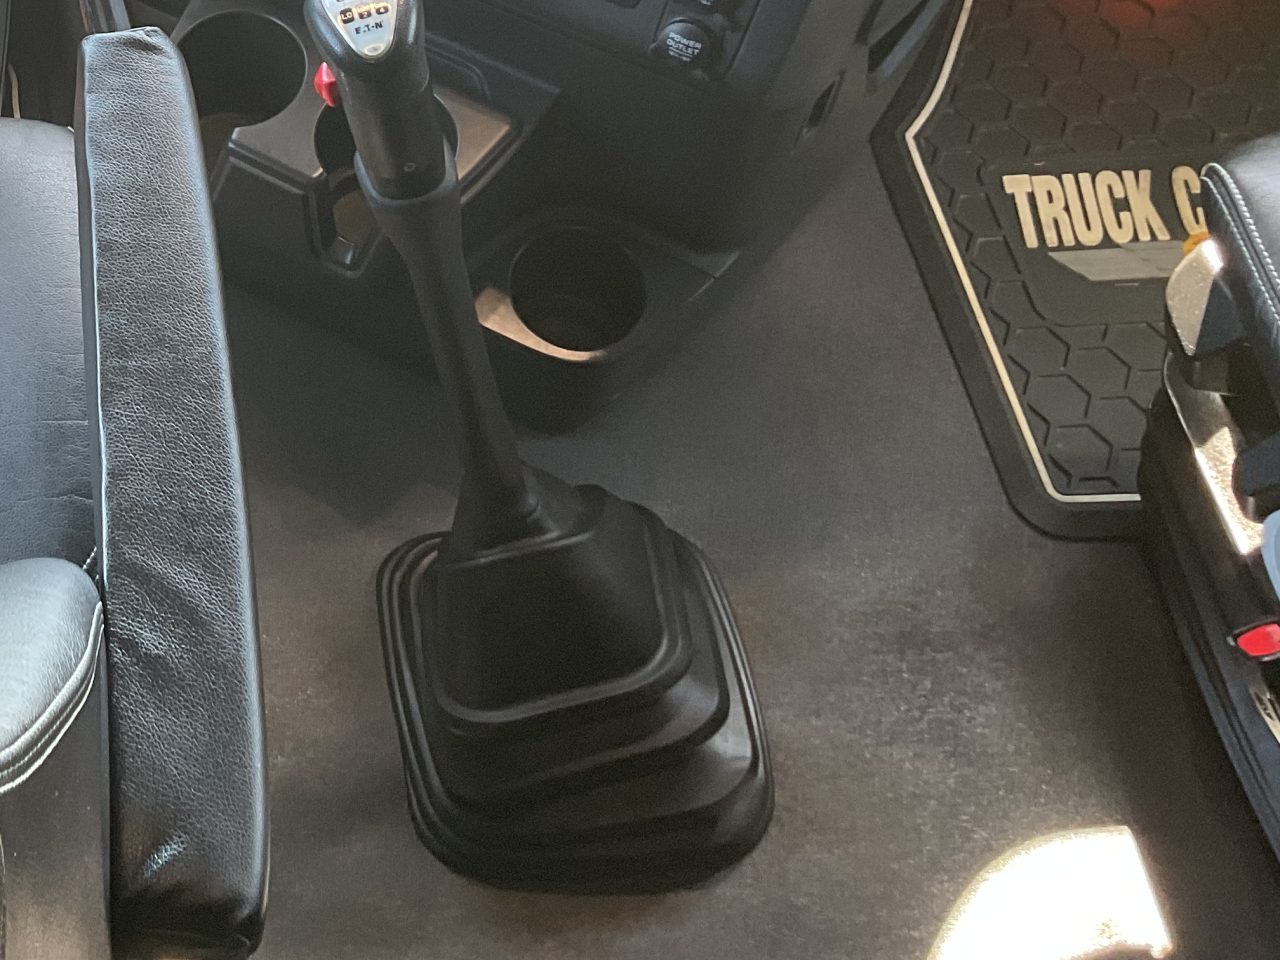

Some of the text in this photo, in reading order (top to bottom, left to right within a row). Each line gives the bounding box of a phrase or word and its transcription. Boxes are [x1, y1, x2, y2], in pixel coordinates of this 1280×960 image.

[666, 38, 700, 56] OUTLET
[668, 32, 702, 49] POWER
[1002, 169, 1170, 249] TRUCK
